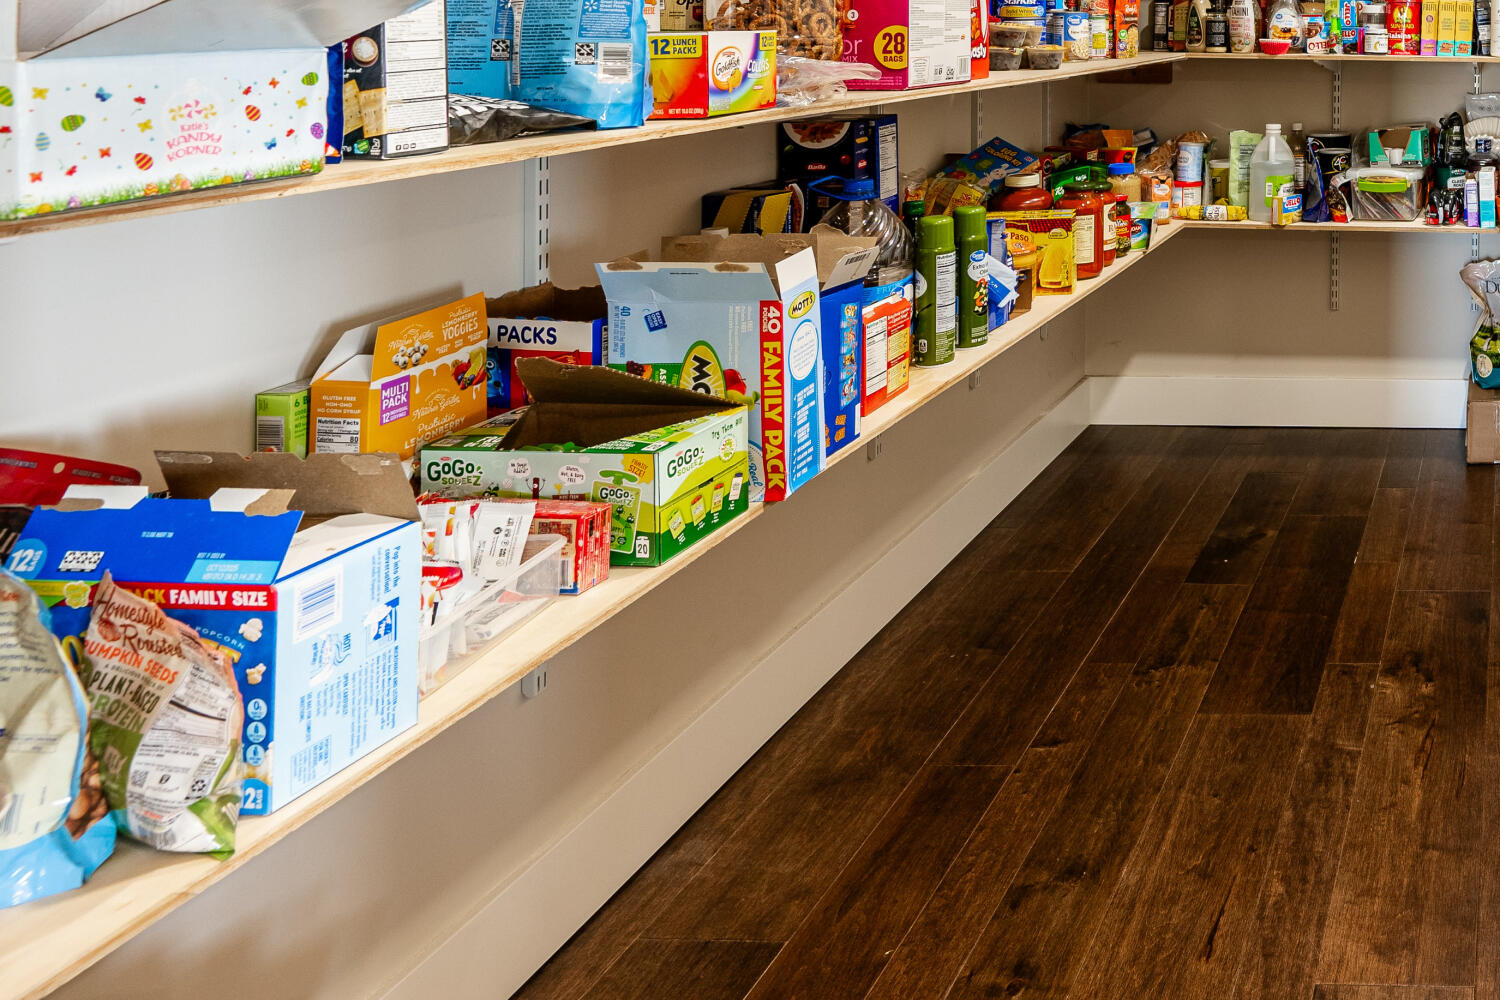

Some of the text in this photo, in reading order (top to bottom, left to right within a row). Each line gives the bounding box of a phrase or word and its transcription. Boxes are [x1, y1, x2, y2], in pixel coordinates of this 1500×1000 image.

[650, 38, 697, 55] 12 LUNCH
[672, 46, 697, 54] PACKS
[761, 36, 767, 47] 12
[881, 32, 905, 55] 28
[970, 44, 987, 59] asty
[166, 131, 223, 149] KANDY
[166, 144, 223, 162] KORNER
[1010, 232, 1029, 241] Paso
[621, 306, 631, 317] 40
[791, 296, 814, 315] MOTT'S
[441, 310, 478, 329] LEMONBERRY
[768, 306, 781, 334] 40
[442, 318, 478, 341] YOGGIES
[497, 324, 557, 345] PACKS
[382, 381, 409, 400] MULTI
[382, 393, 407, 411] PACK
[382, 412, 389, 424] 12
[763, 341, 785, 490] FAMILY PACK
[404, 416, 465, 450] LEMONBERRY
[426, 459, 475, 482] GoGo
[628, 464, 646, 478] SIZE!
[667, 446, 699, 479] GoGo
[600, 487, 629, 500] GoGo
[392, 545, 400, 560] Pop
[637, 544, 648, 555] 20
[10, 548, 32, 572] 12
[136, 588, 268, 607] ACK FAMILY SIZE
[92, 586, 166, 635] Homestyle
[194, 625, 246, 650] POPCORN
[84, 639, 179, 685] PUMPKIN SEEDS
[90, 670, 161, 714] PLANT-BASED
[89, 691, 147, 734] PROTEIN
[244, 787, 256, 810] 2
